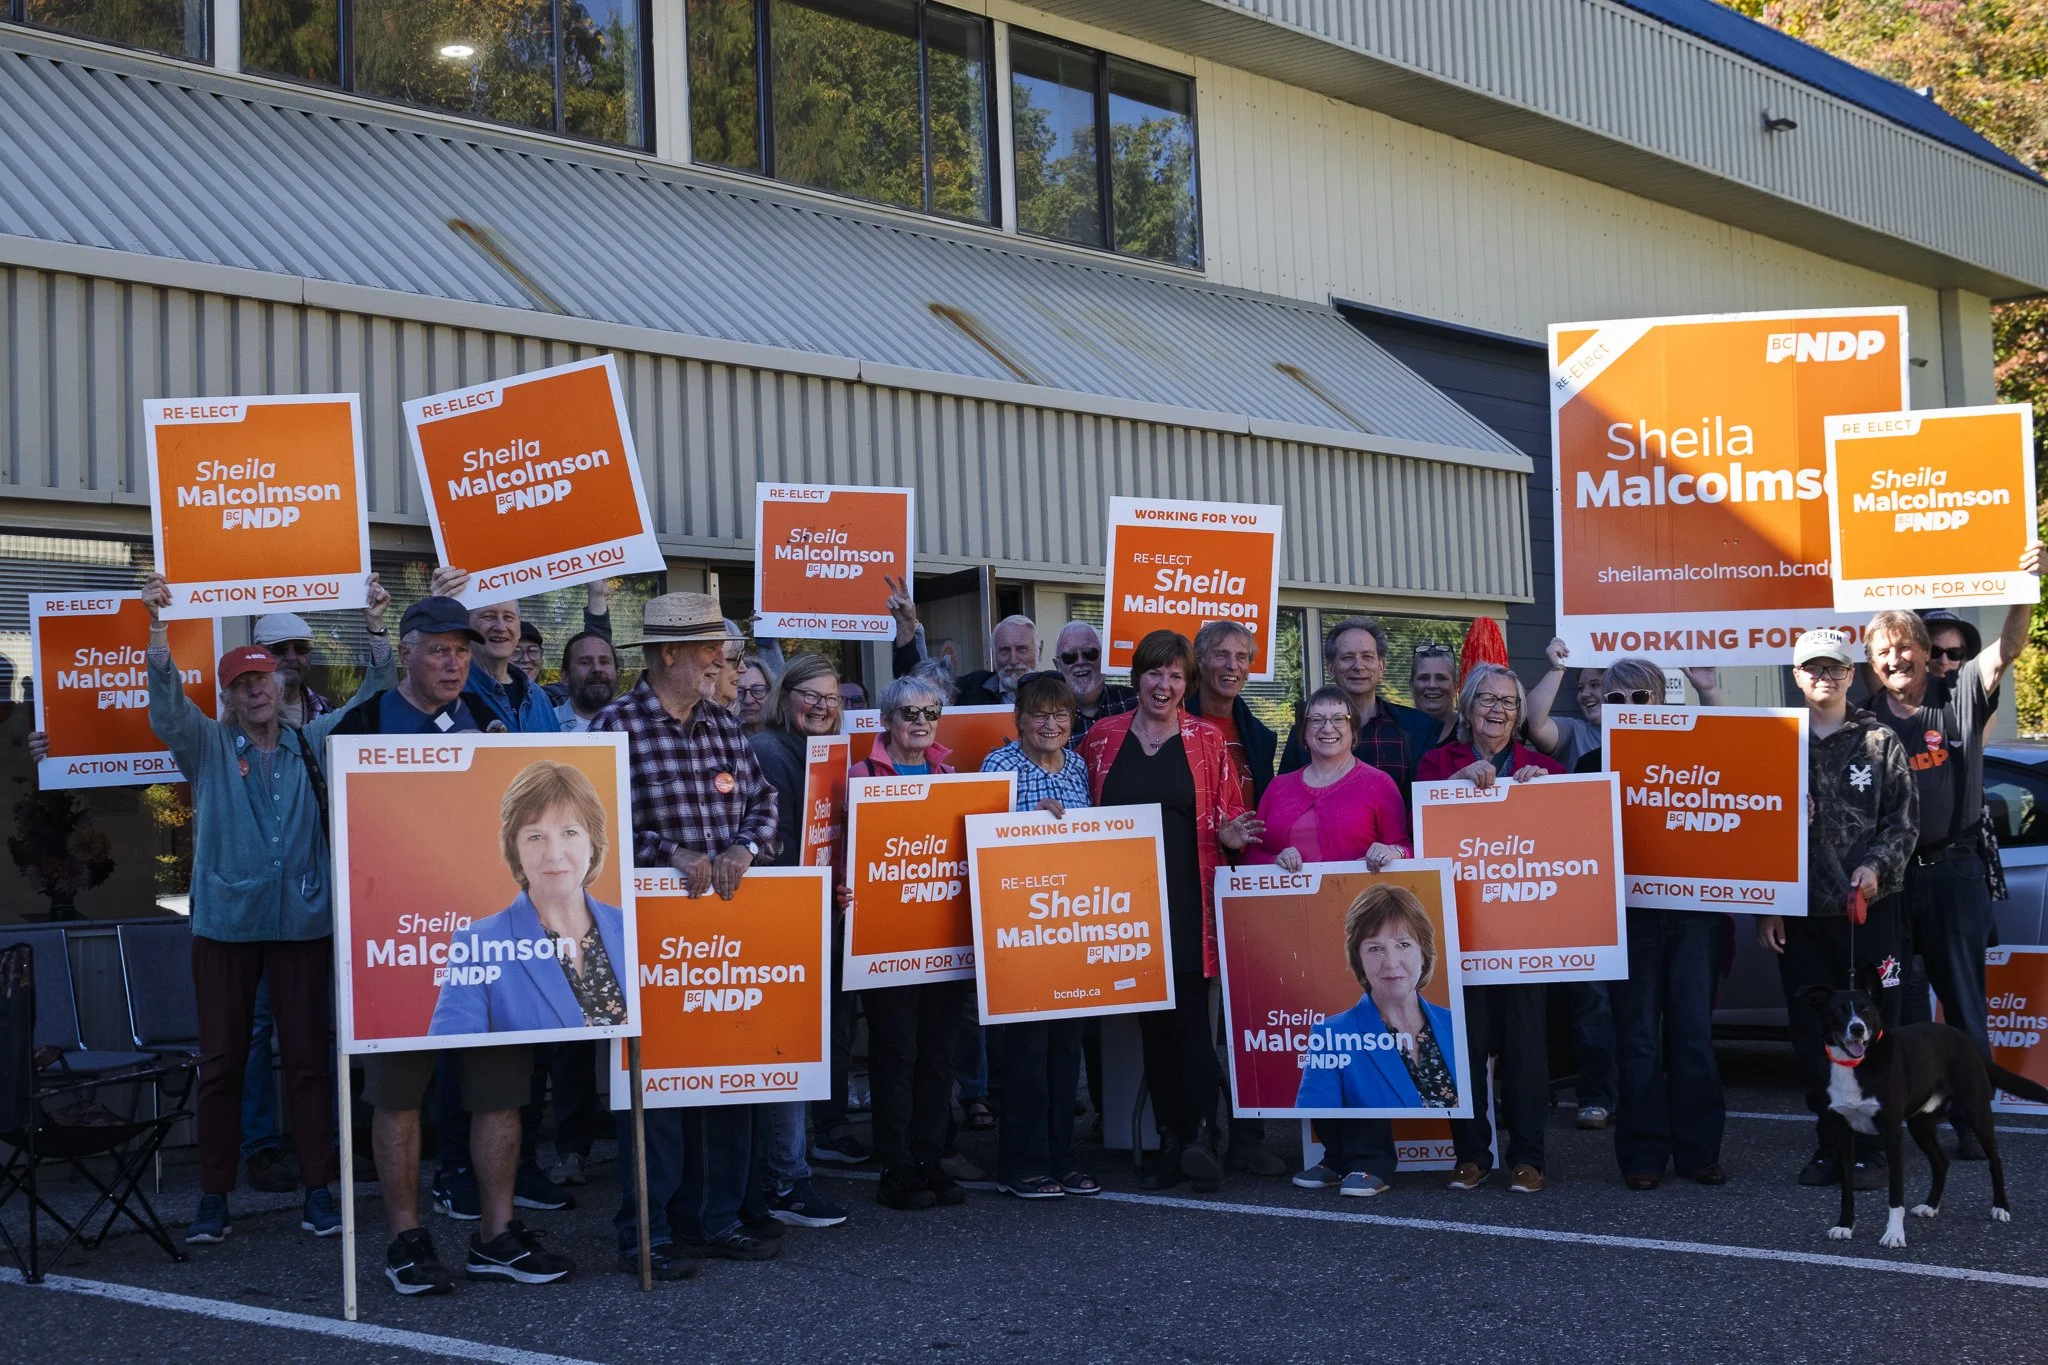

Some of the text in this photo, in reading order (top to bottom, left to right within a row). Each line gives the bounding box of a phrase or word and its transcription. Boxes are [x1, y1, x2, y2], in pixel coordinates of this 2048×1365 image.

[163, 404, 239, 420] RE-ELECT
[421, 390, 496, 418] RE-ELECT
[1606, 415, 1754, 461] Sheila
[462, 439, 541, 473] Sheila
[195, 457, 277, 482] Sheila
[447, 449, 611, 501] Malcolmson
[1870, 466, 1948, 490] Sheila
[177, 481, 341, 508] Malcolmson
[769, 489, 825, 500] RE-ELECT
[1575, 462, 1829, 509] Malcolms
[1853, 487, 2010, 513] Malcolmson
[1135, 509, 1257, 525] WORKING FOR YOU
[789, 528, 848, 545] Sheila
[774, 544, 895, 564] Malcolmson
[1133, 553, 1193, 566] RE-ELECT
[477, 546, 625, 593] ACTION FOR YOU
[1597, 559, 1833, 585] sheilamalcolmson.bcnd
[189, 581, 340, 605] ACTION FOR YOU
[1153, 568, 1246, 596] Sheila
[1863, 579, 2006, 598] ACTION FOR YOU
[46, 599, 114, 612] RE-ELECT
[1123, 594, 1259, 618] Malcolmson
[777, 617, 889, 631] ACTION FOR YOU
[1590, 629, 1739, 653] WORKING
[74, 645, 146, 668] Sheila
[57, 666, 202, 690] Malcolmon
[115, 690, 150, 710] ND
[1618, 713, 1689, 726] RE-ELECT
[67, 760, 128, 776] ACTION
[133, 758, 164, 771] FOR
[358, 747, 463, 765] RE-ELECT
[1643, 764, 1721, 786] Sheila
[864, 783, 924, 798] RE-ELECT
[1430, 785, 1502, 801] RE-ELECT
[1626, 786, 1782, 811] Malcolmson
[814, 798, 832, 821] Sheila
[996, 818, 1135, 839] WORKING FOR YOU
[884, 834, 948, 859] Sheila
[1458, 835, 1535, 858] Sheila
[868, 858, 969, 883] Malcolms
[1001, 874, 1068, 890] RE-ELECT
[634, 877, 688, 892] RE-ELE
[1229, 874, 1313, 892] RE-ELECT
[1631, 881, 1775, 901] ACTION FOR YOU
[1028, 885, 1131, 920] Sheila
[396, 911, 472, 935] Sheila
[996, 920, 1150, 949] Malcolmson
[366, 933, 577, 968] Malcolmson
[659, 935, 742, 960] Sheila
[640, 961, 806, 987] Malcolmson
[868, 952, 976, 975] ACTION FOR YO
[1460, 953, 1595, 972] CTION FOR YOU
[1053, 987, 1101, 1000] bcndp.ca
[1987, 992, 2027, 1010] eila
[1266, 1009, 1326, 1027] Sheila
[1986, 1011, 2048, 1031] colms
[1243, 1027, 1414, 1052] Malcolmson
[645, 1071, 799, 1093] ACTION FOR YOU
[1397, 1145, 1456, 1159] FOR YO
